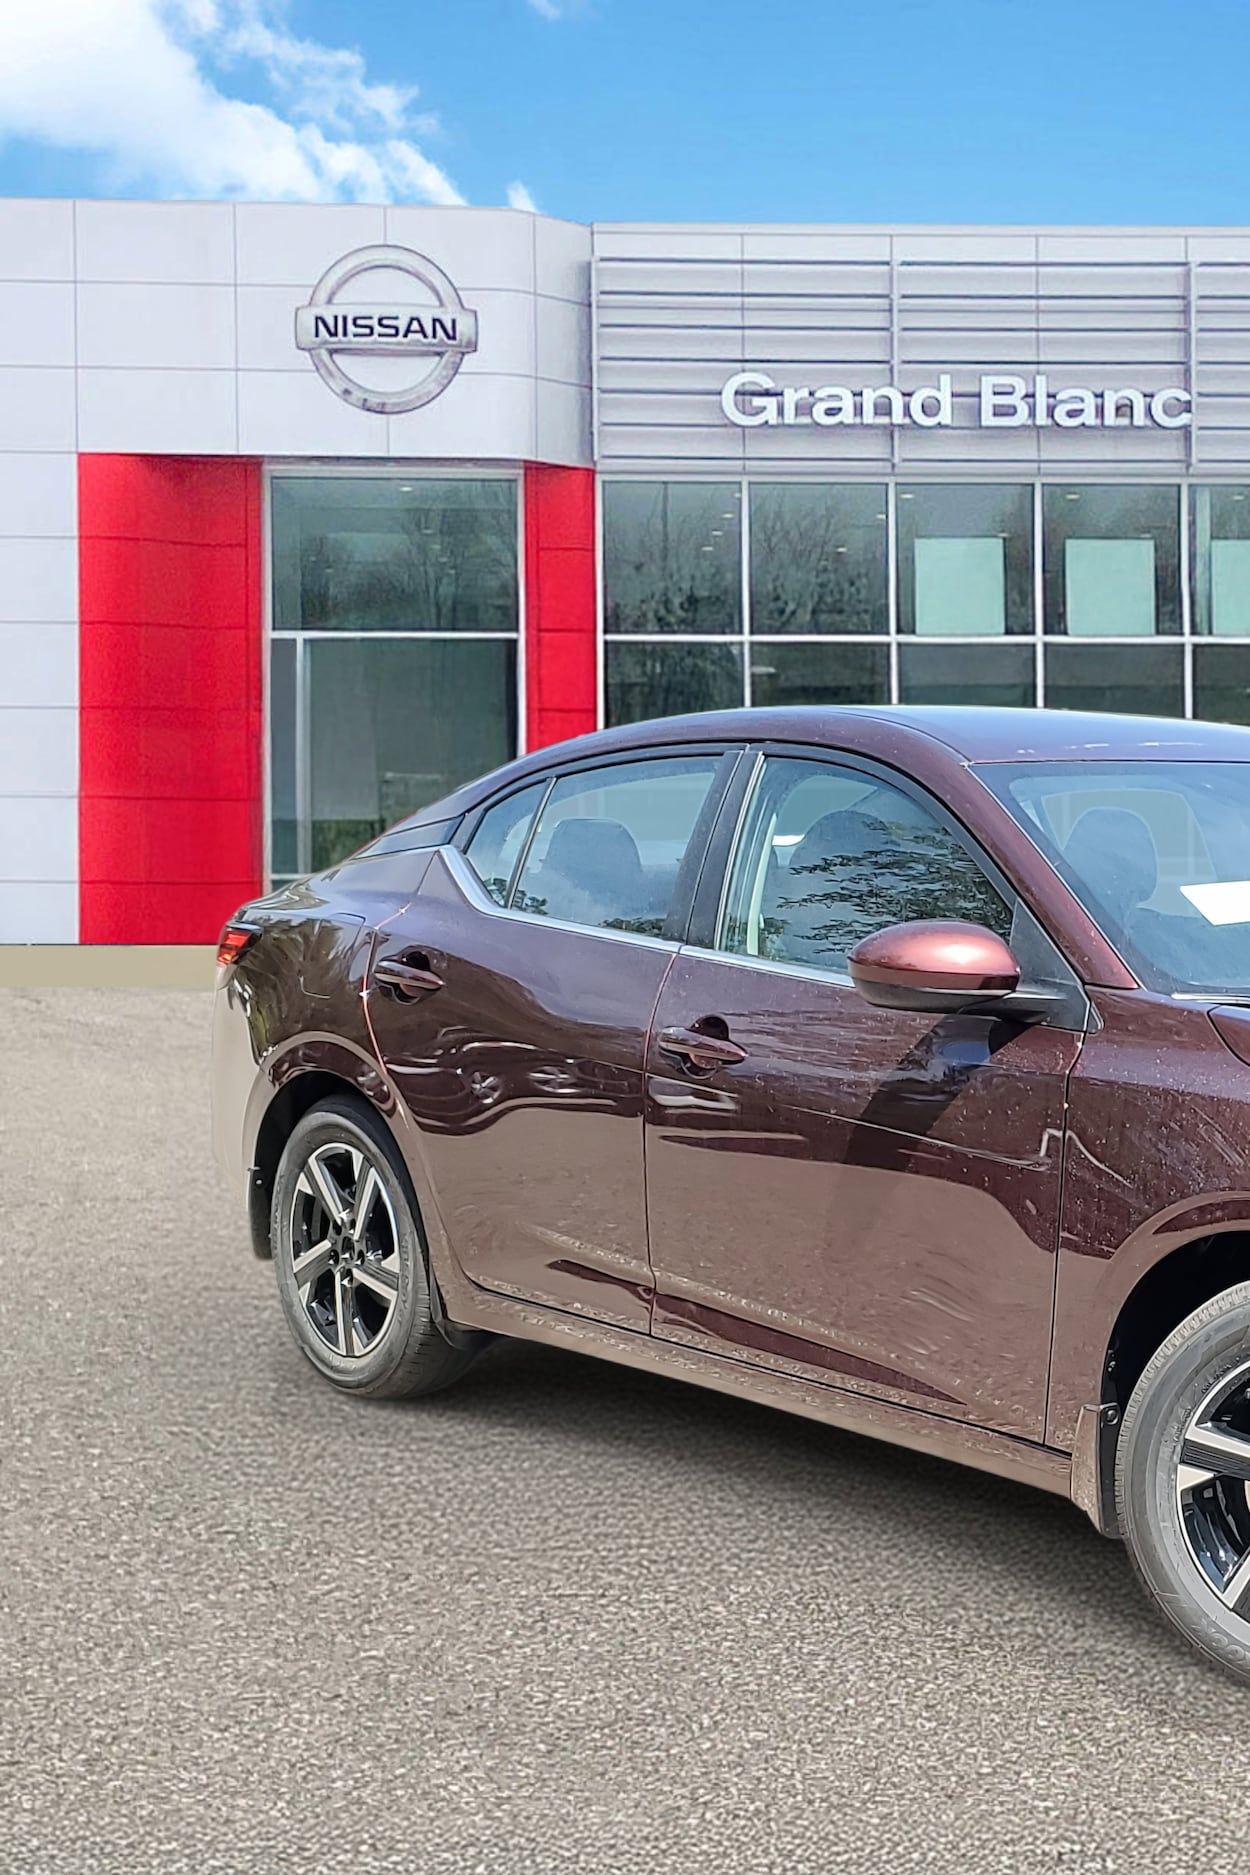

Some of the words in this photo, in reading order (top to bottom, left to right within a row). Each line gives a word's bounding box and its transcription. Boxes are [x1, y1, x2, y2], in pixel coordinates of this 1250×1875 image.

[314, 315, 458, 341] NISSAN
[720, 371, 952, 427] Grand
[979, 374, 1193, 428] Blanc
